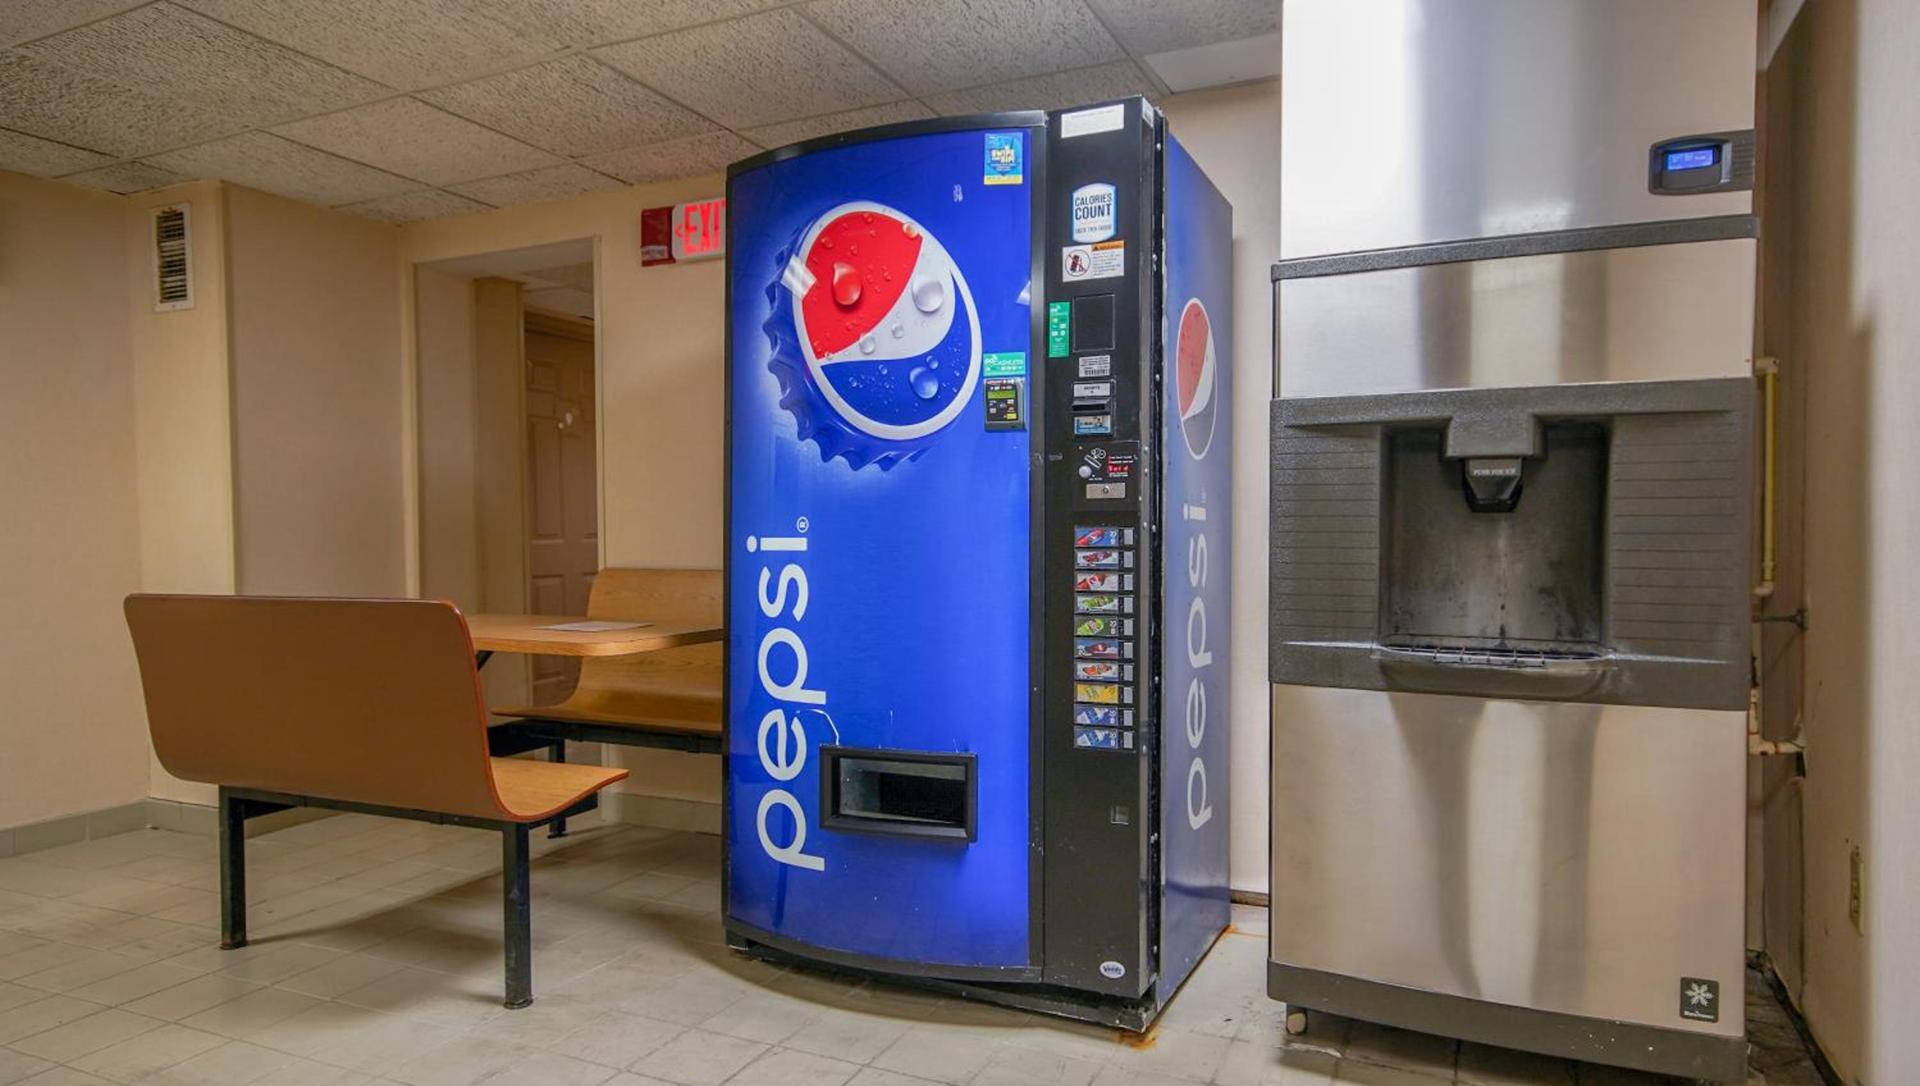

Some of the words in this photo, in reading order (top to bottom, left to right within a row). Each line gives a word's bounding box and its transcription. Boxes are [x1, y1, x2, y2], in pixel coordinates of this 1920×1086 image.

[1075, 193, 1112, 206] CALORIES
[1075, 203, 1112, 220] COUNT
[746, 535, 826, 872] pepsi
[1183, 503, 1213, 830] pepsi
